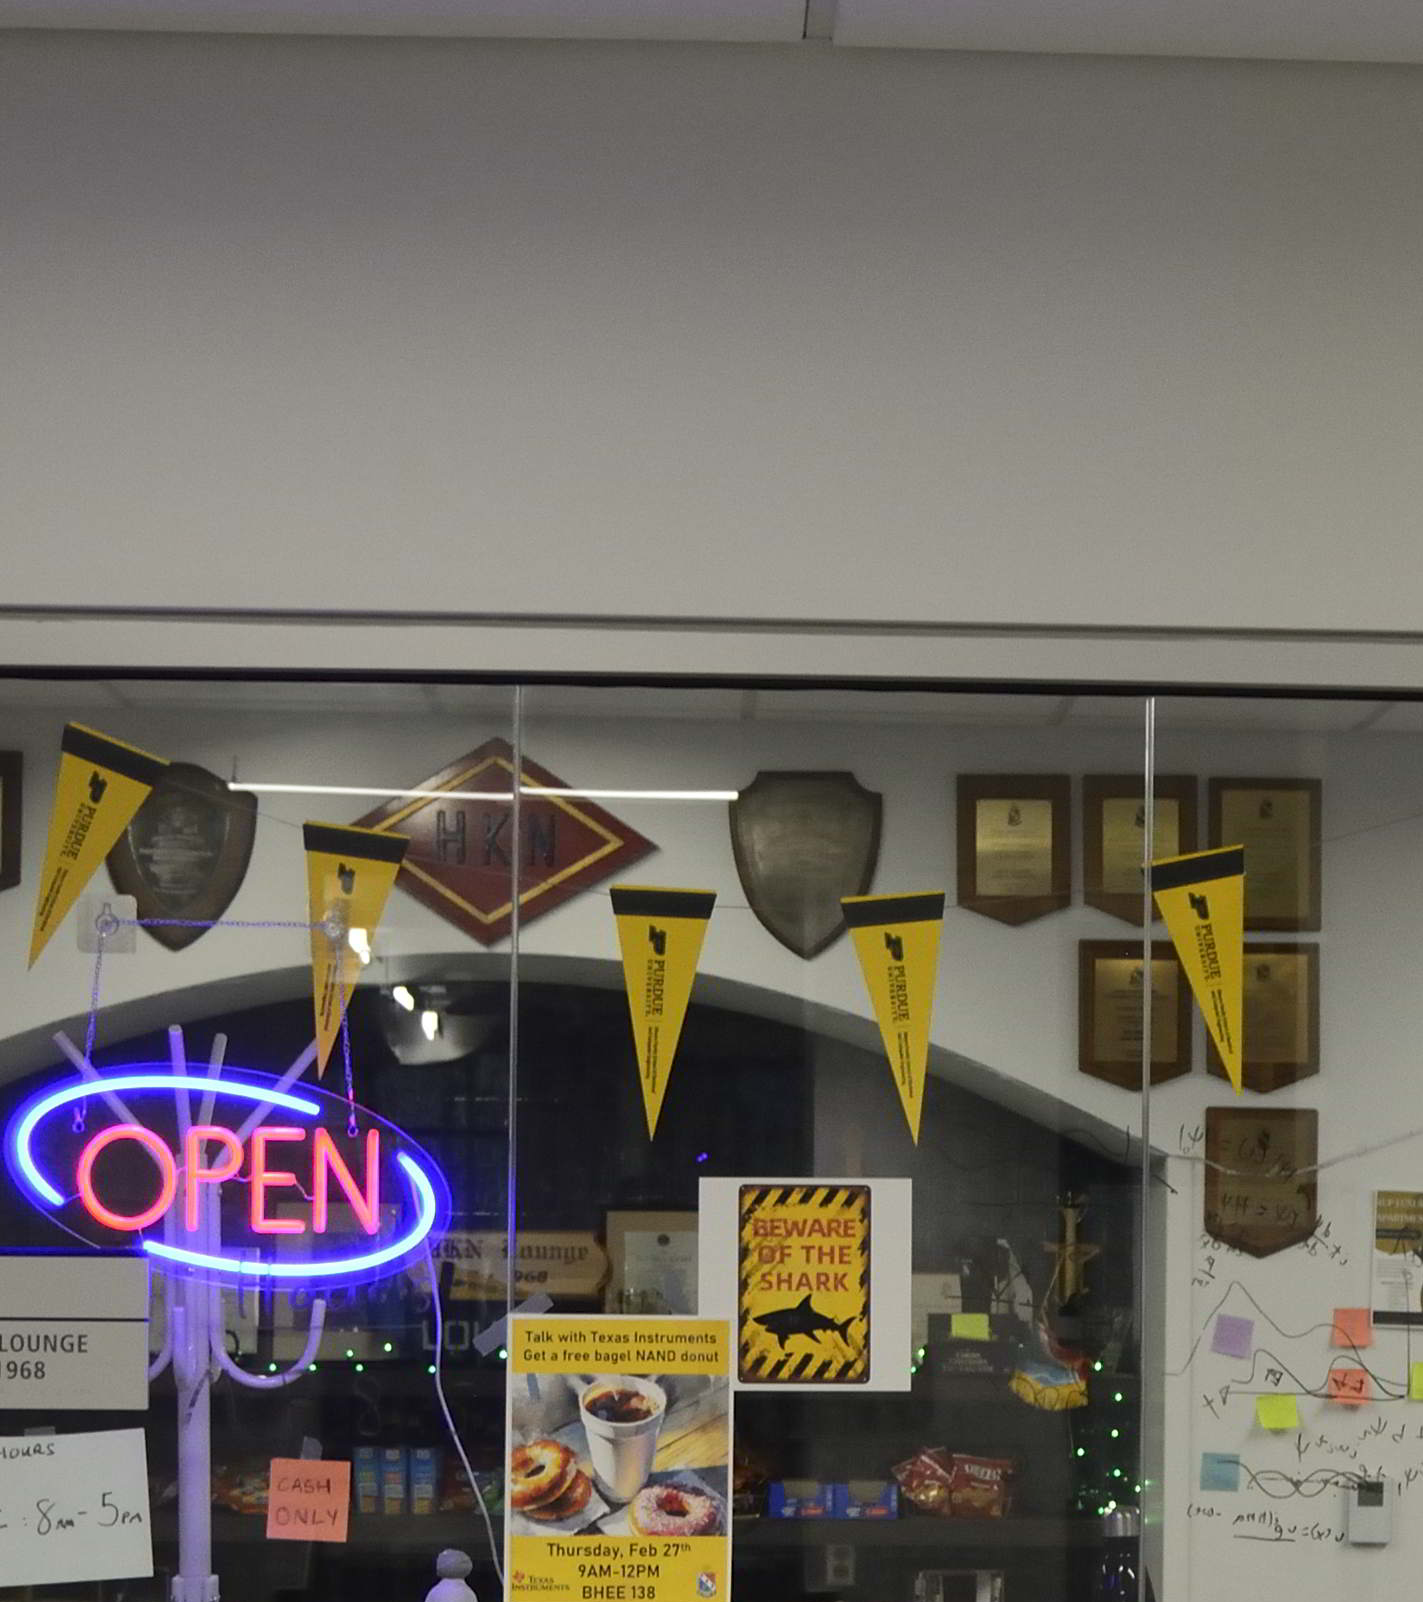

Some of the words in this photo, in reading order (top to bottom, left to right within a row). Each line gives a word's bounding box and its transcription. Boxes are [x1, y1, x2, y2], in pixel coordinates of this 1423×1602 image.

[67, 807, 97, 861] PURDUE
[436, 808, 556, 868] HKN
[1200, 923, 1221, 979] PURDUE
[652, 959, 665, 1016] PURDUE
[894, 965, 910, 1022] PURDUE
[77, 1123, 381, 1236] OPEN
[752, 1218, 856, 1238] BEWARE
[758, 1245, 792, 1265] OF
[800, 1245, 852, 1265] THE
[759, 1272, 849, 1292] SHARK
[525, 1330, 553, 1344] Talk
[558, 1330, 586, 1344] with
[590, 1331, 630, 1344] Texas
[634, 1332, 717, 1345] Instruments
[523, 1349, 546, 1362] Get
[550, 1351, 558, 1362] a
[562, 1349, 590, 1362] free
[594, 1349, 631, 1365] bagel
[636, 1350, 677, 1362] NAND
[681, 1350, 719, 1363] donut
[278, 1477, 331, 1495] CASH
[277, 1506, 338, 1527] ONLY
[547, 1542, 624, 1561] Thursday,
[629, 1543, 657, 1558] Feb
[663, 1542, 692, 1558] 27th
[577, 1564, 660, 1579] 9AM-12PM
[582, 1585, 626, 1600] BHEE
[631, 1585, 657, 1600] 138
